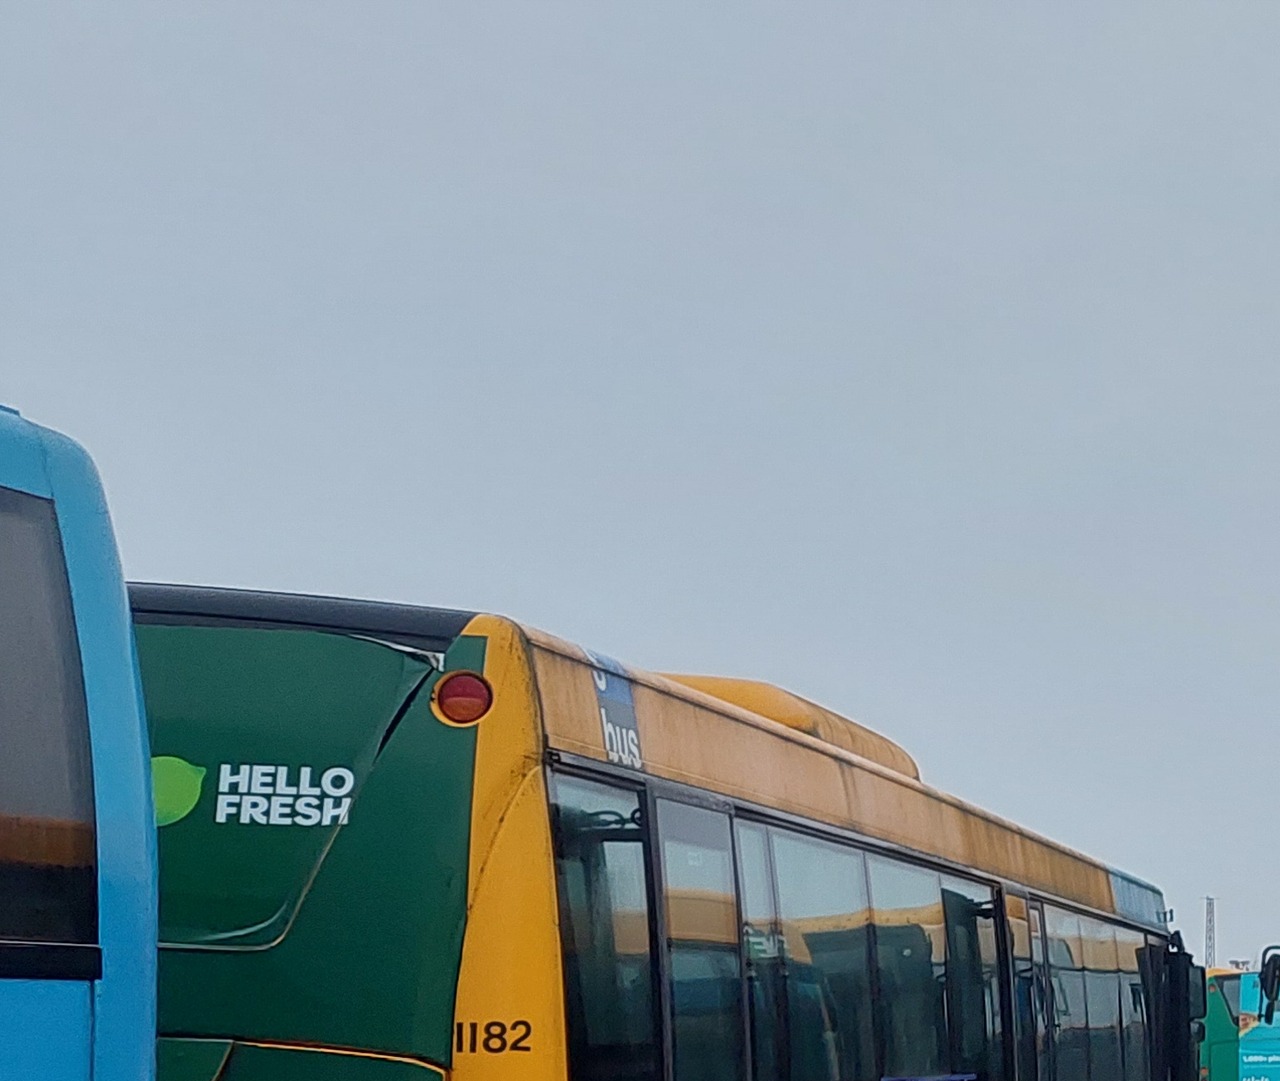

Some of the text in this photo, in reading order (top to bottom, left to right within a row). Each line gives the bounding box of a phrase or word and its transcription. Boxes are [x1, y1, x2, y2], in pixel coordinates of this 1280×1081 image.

[600, 707, 641, 769] bus
[218, 763, 355, 797] HELLO
[215, 794, 352, 826] FRESH
[456, 1020, 532, 1054] 1182
